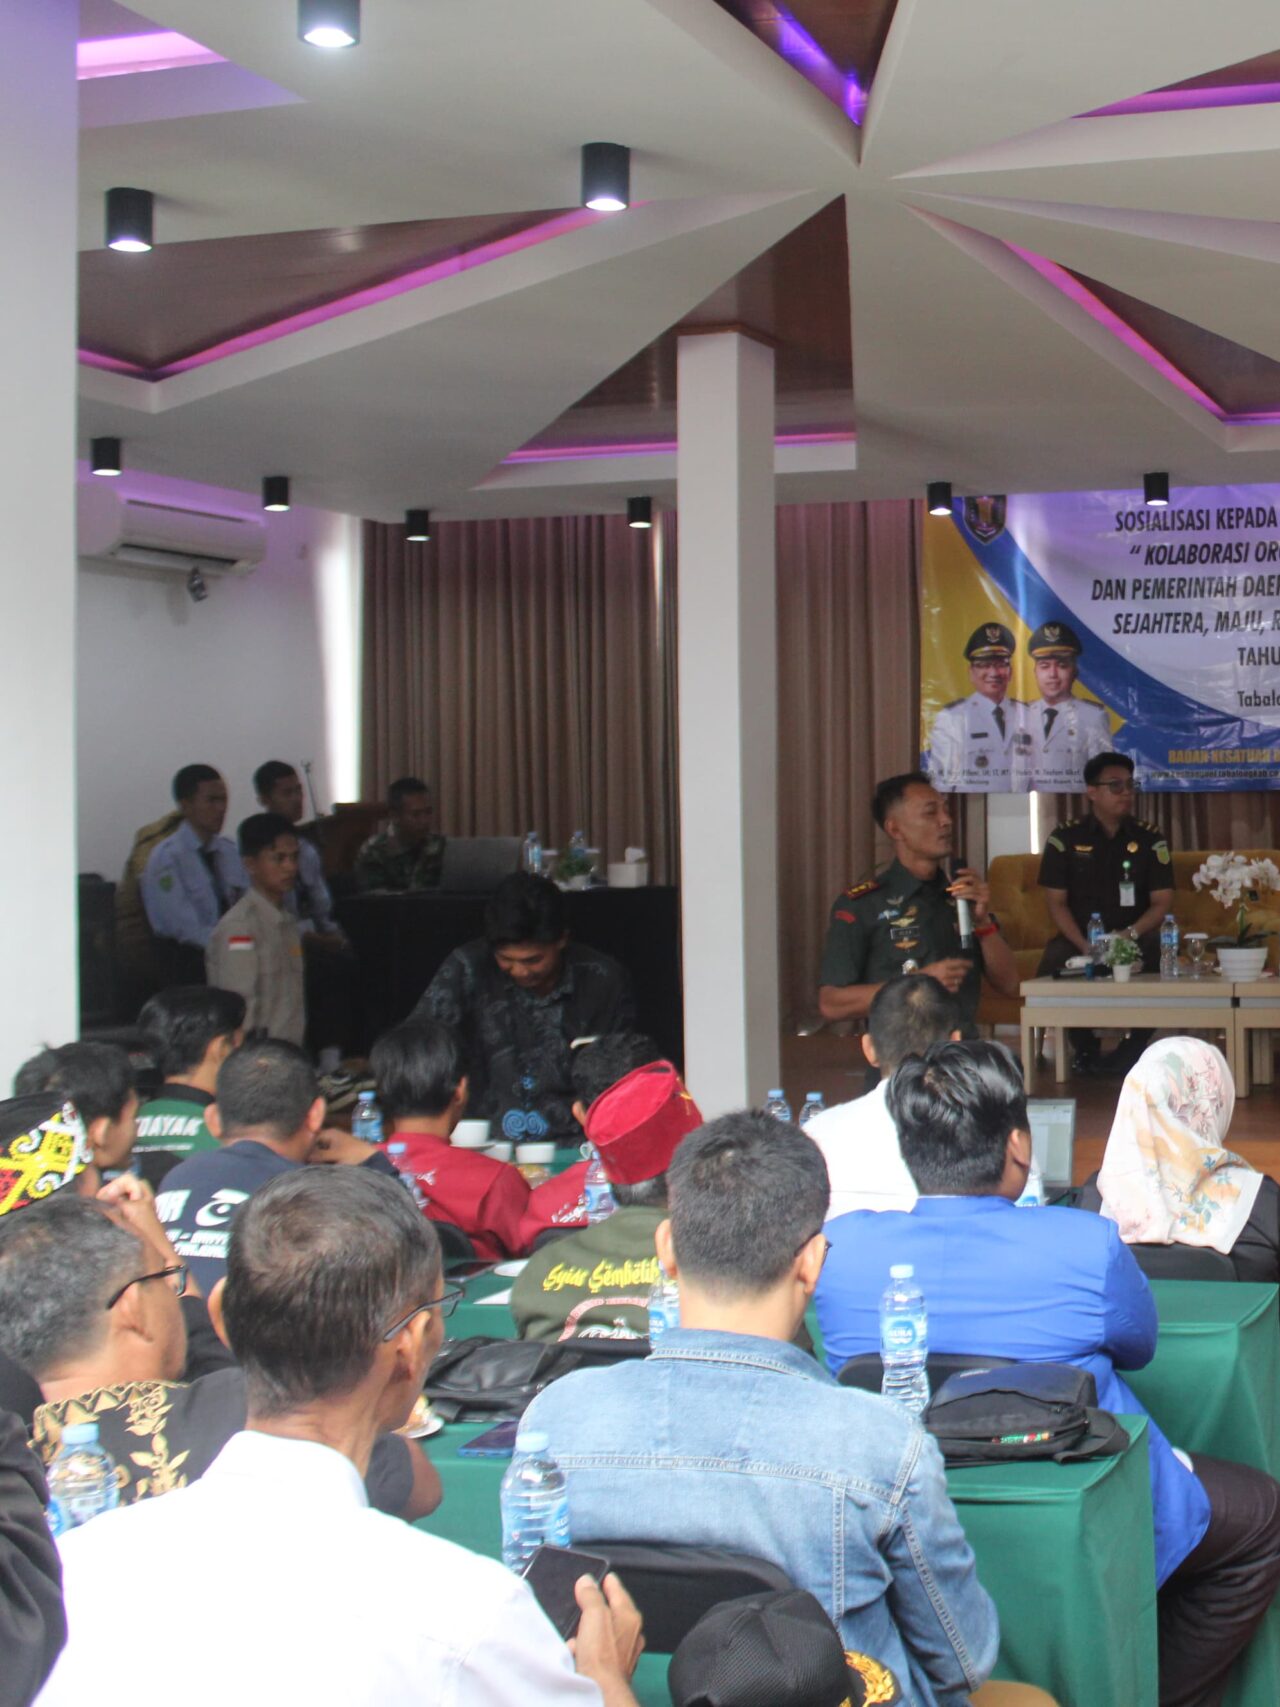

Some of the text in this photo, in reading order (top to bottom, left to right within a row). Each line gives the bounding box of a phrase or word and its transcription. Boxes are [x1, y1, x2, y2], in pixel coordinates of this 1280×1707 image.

[1114, 508, 1211, 532] SOSIALISASI
[1216, 506, 1278, 530] KEPADA
[1144, 541, 1250, 566] KOLABORASI
[1091, 578, 1127, 601] DAN
[1131, 576, 1238, 601] PEMERINTAH
[1112, 612, 1209, 637] SEJAHTERA,
[1213, 610, 1265, 636] MAJU,
[1168, 749, 1209, 763] BADAN
